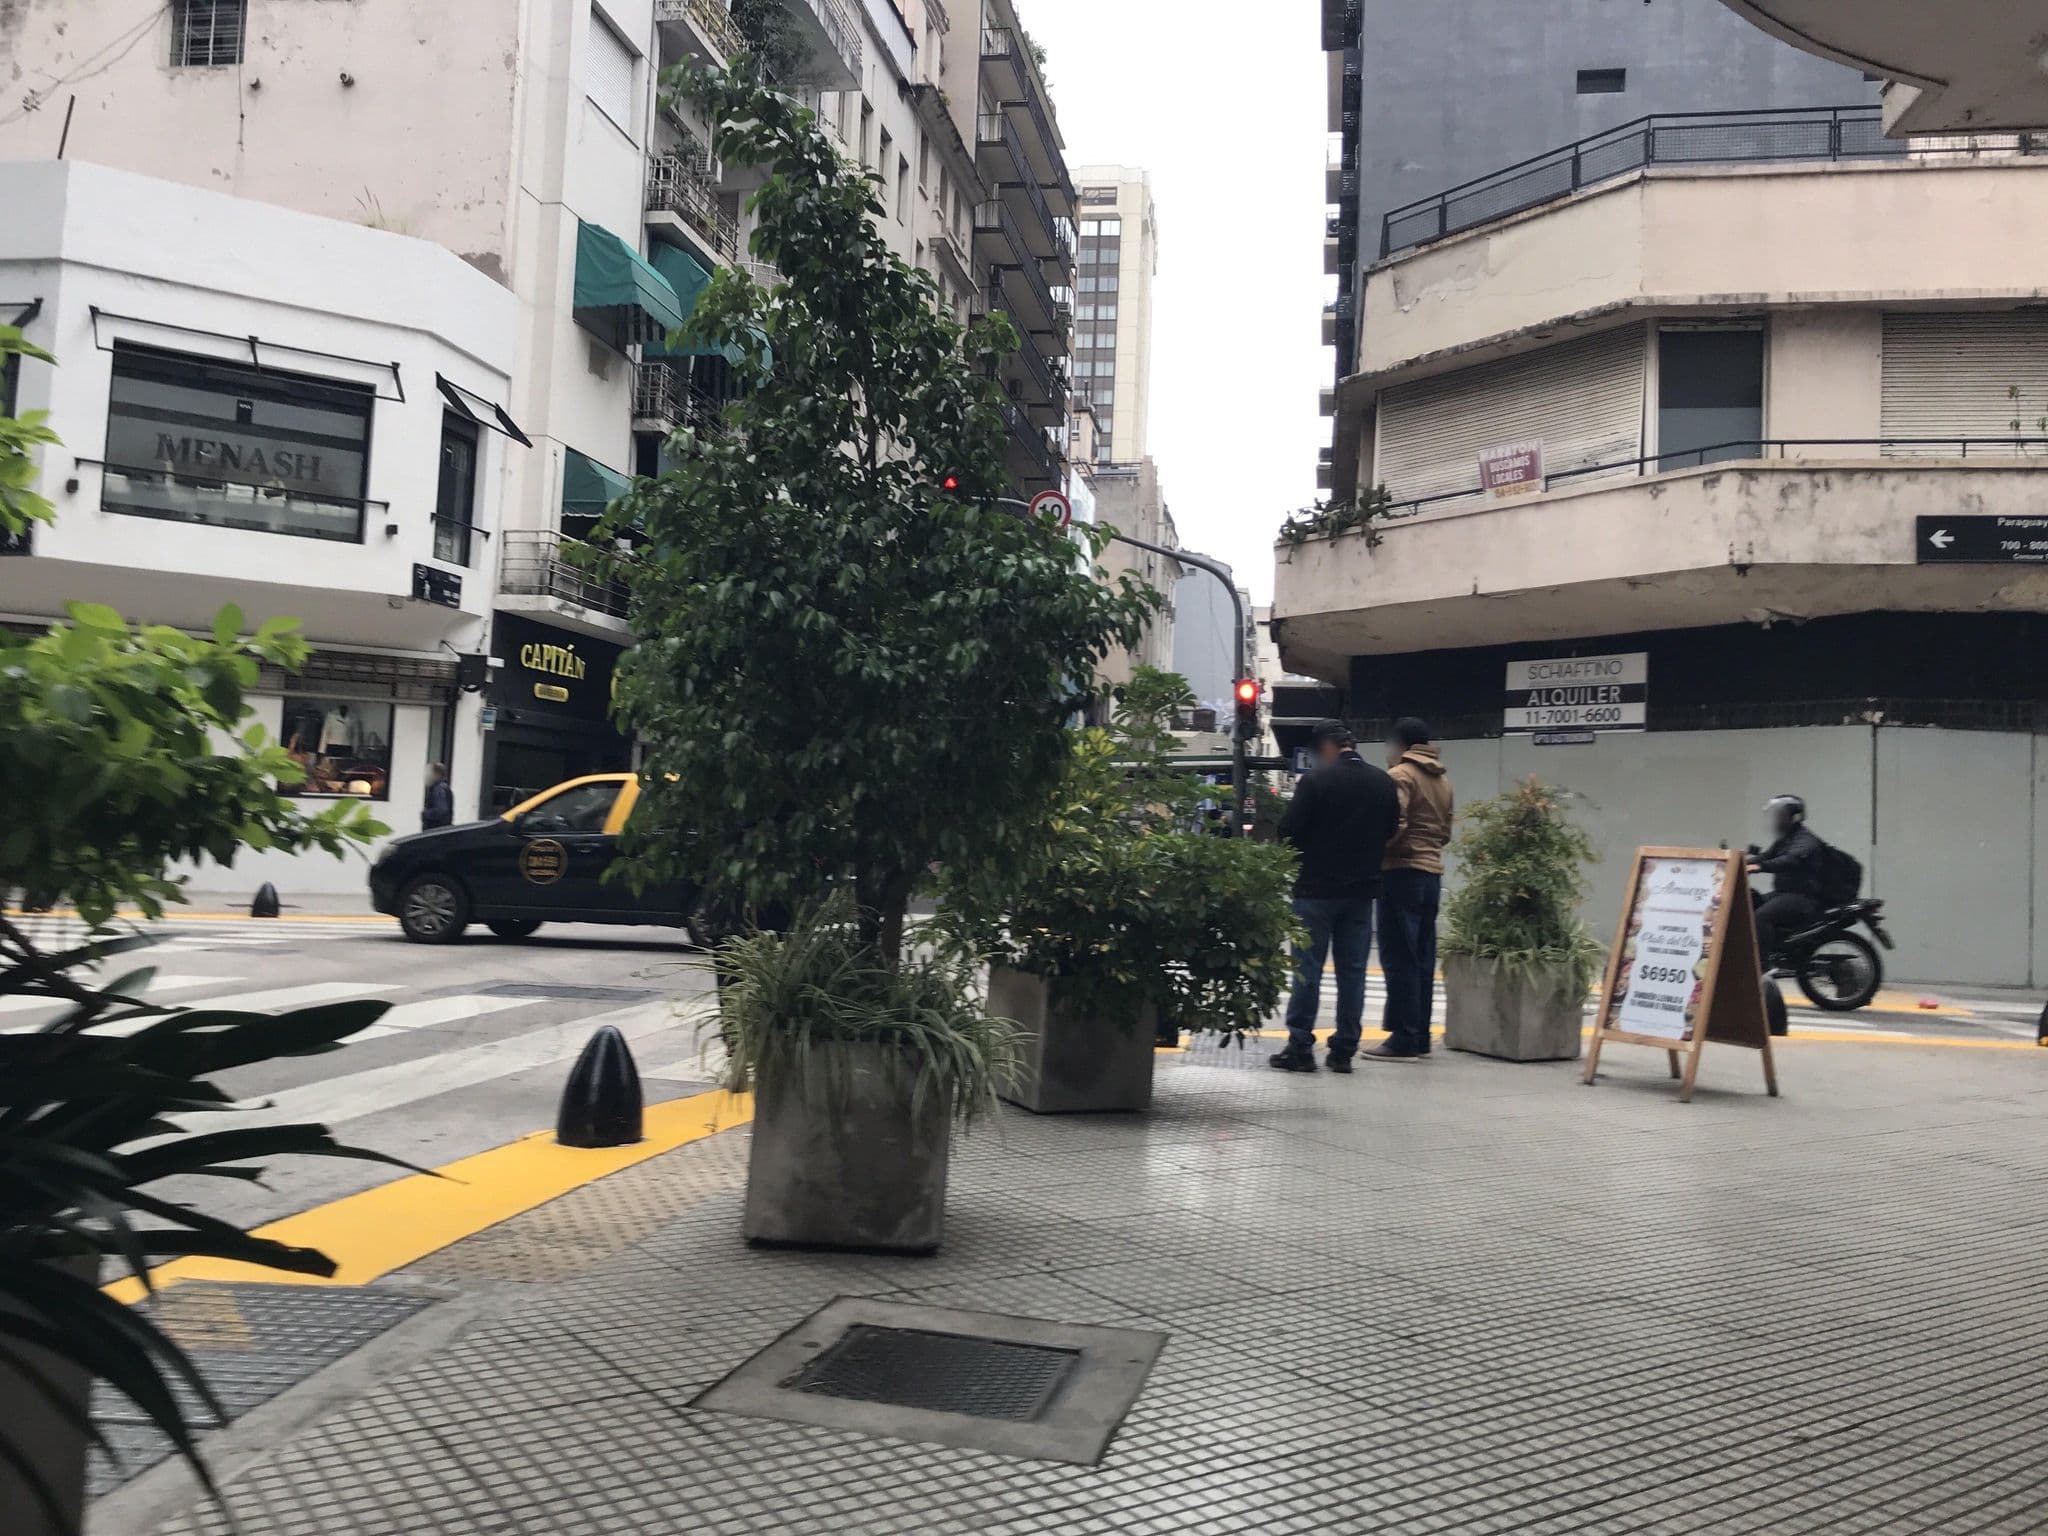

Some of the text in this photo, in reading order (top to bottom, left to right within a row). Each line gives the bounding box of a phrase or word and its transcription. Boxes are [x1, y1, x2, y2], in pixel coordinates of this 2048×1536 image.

[154, 432, 322, 482] MENASH
[520, 643, 586, 680] CAPITÁN
[1527, 660, 1623, 680] SCHIAFFINO
[1526, 686, 1622, 707] ALQUILER
[1525, 707, 1622, 725] 11-7001-6600
[1639, 964, 1687, 984] $6950
